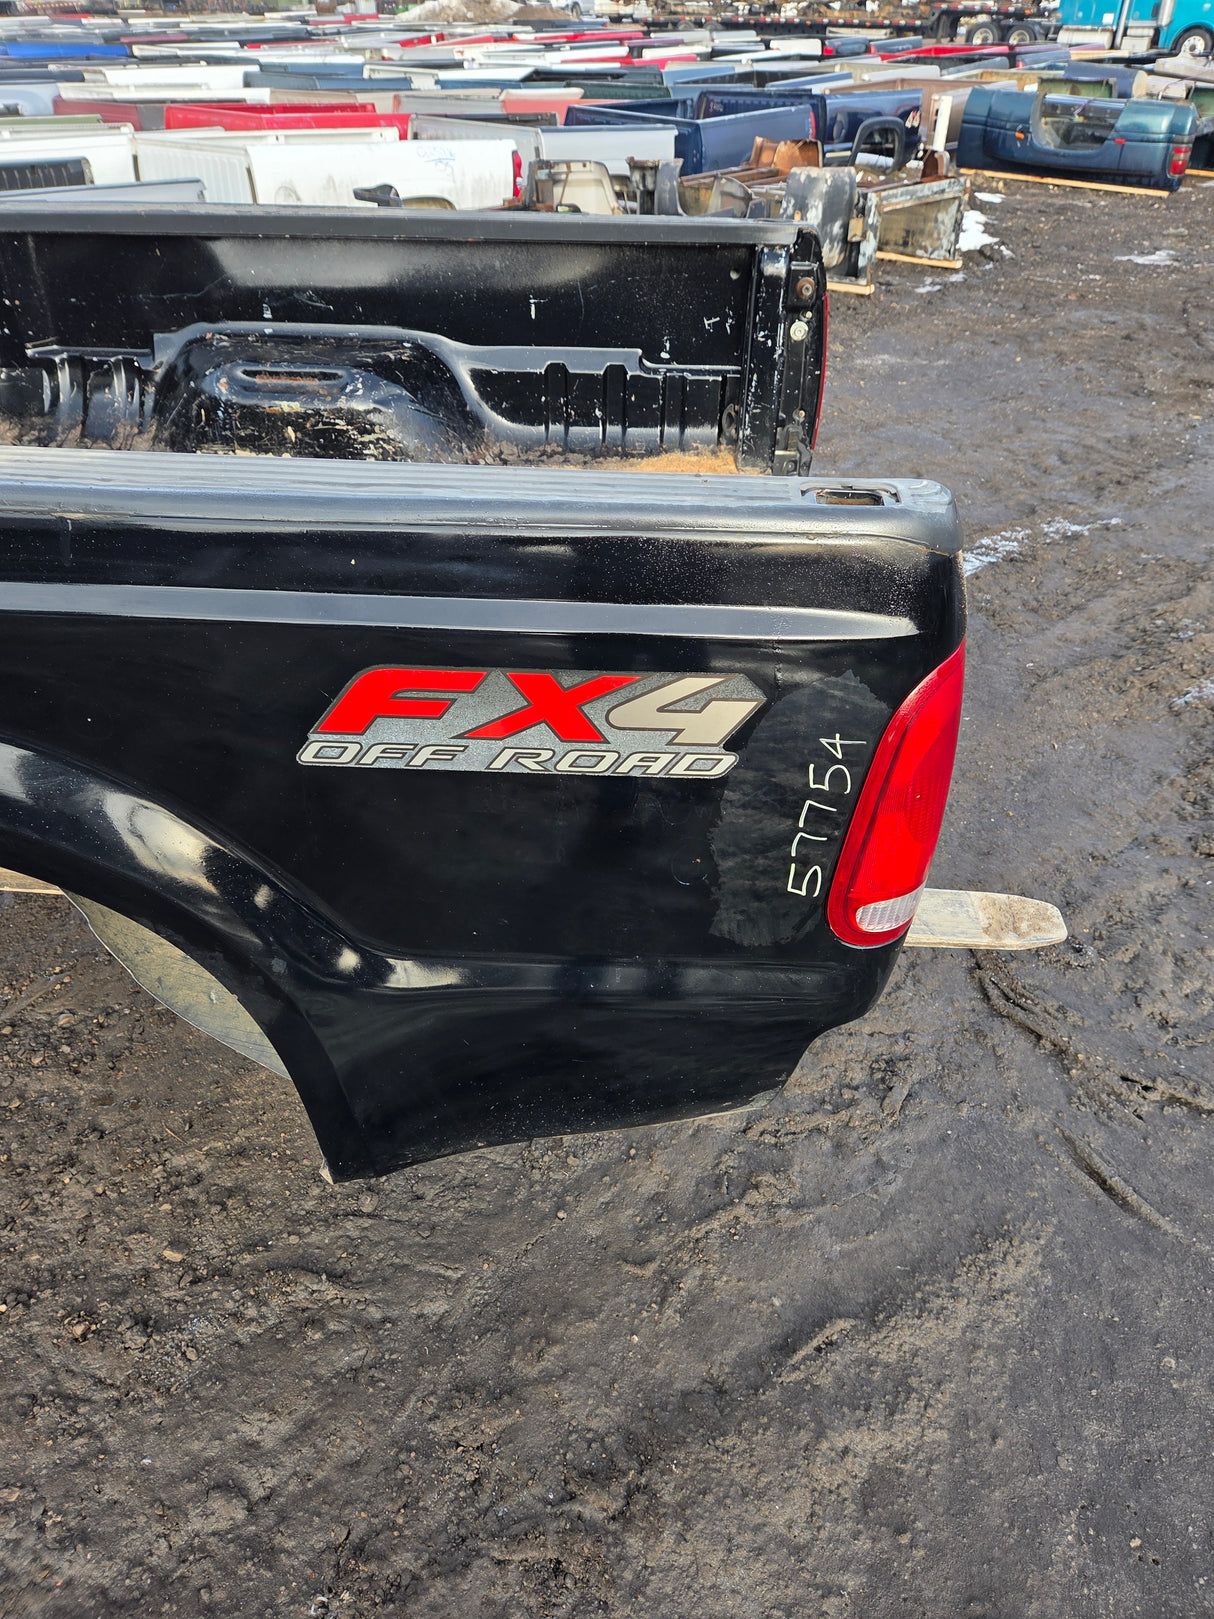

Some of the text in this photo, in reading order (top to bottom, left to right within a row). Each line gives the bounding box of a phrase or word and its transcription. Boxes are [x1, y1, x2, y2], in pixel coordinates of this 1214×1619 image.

[314, 668, 766, 746] FX4
[299, 740, 738, 777] OFF ROAD
[786, 732, 867, 898] 57754
